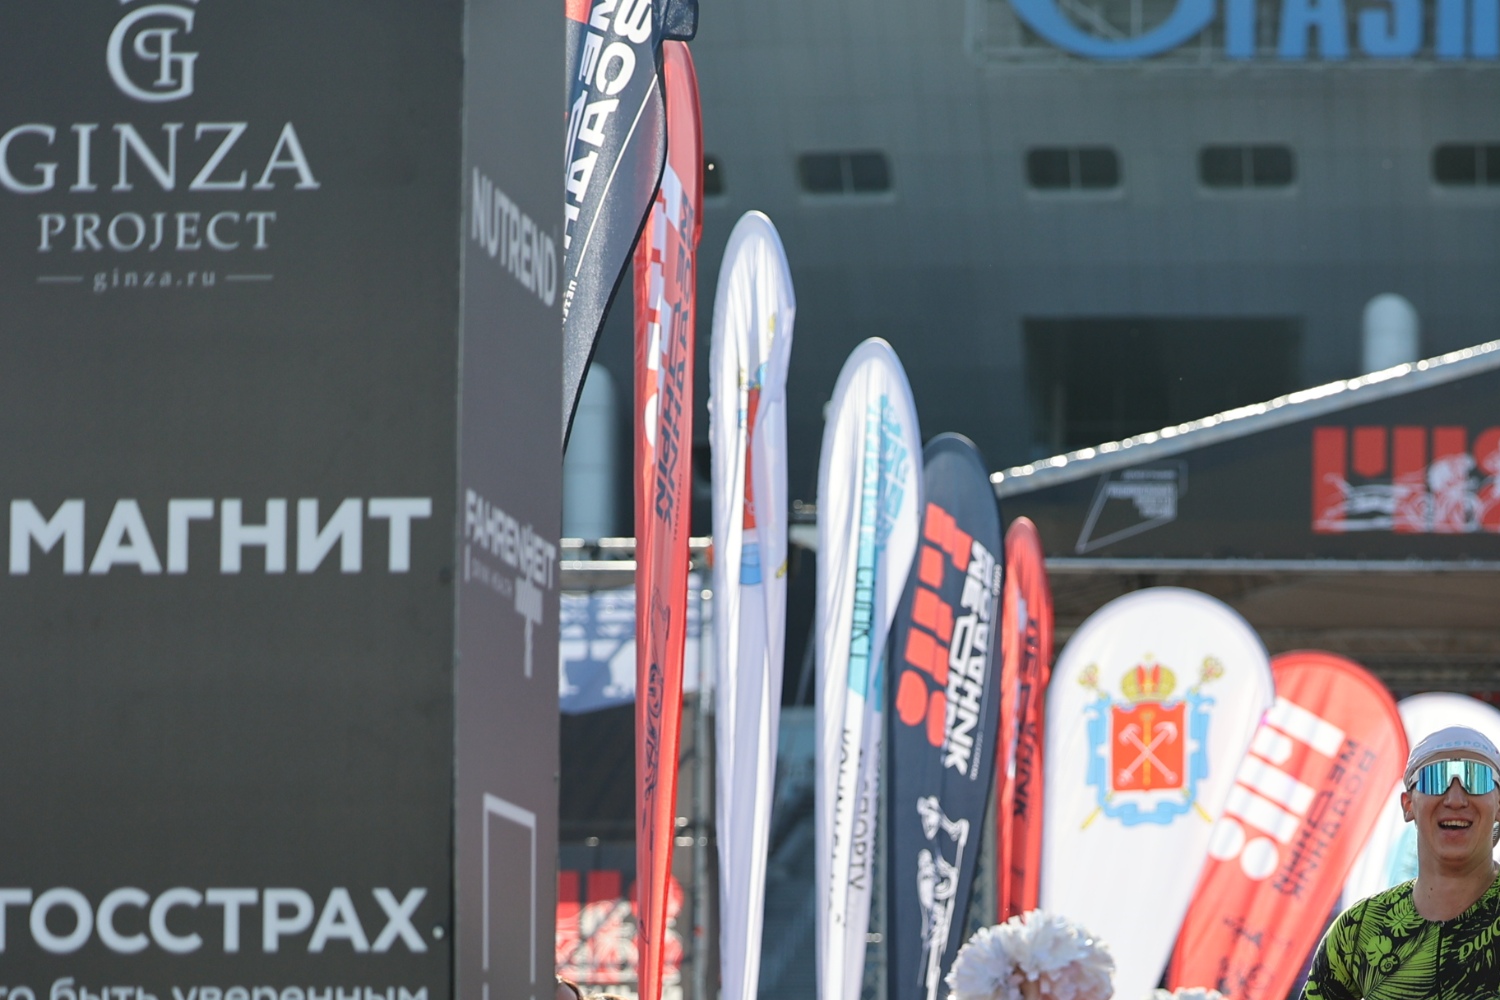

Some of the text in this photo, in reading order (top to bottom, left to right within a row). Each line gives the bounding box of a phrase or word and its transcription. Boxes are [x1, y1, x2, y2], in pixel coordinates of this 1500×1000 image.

[0, 121, 321, 194] GINZA
[38, 211, 277, 253] PROJECT
[472, 167, 557, 307] NUTREND
[93, 268, 217, 292] ginza.ru
[9, 497, 433, 576] МАГНИТ
